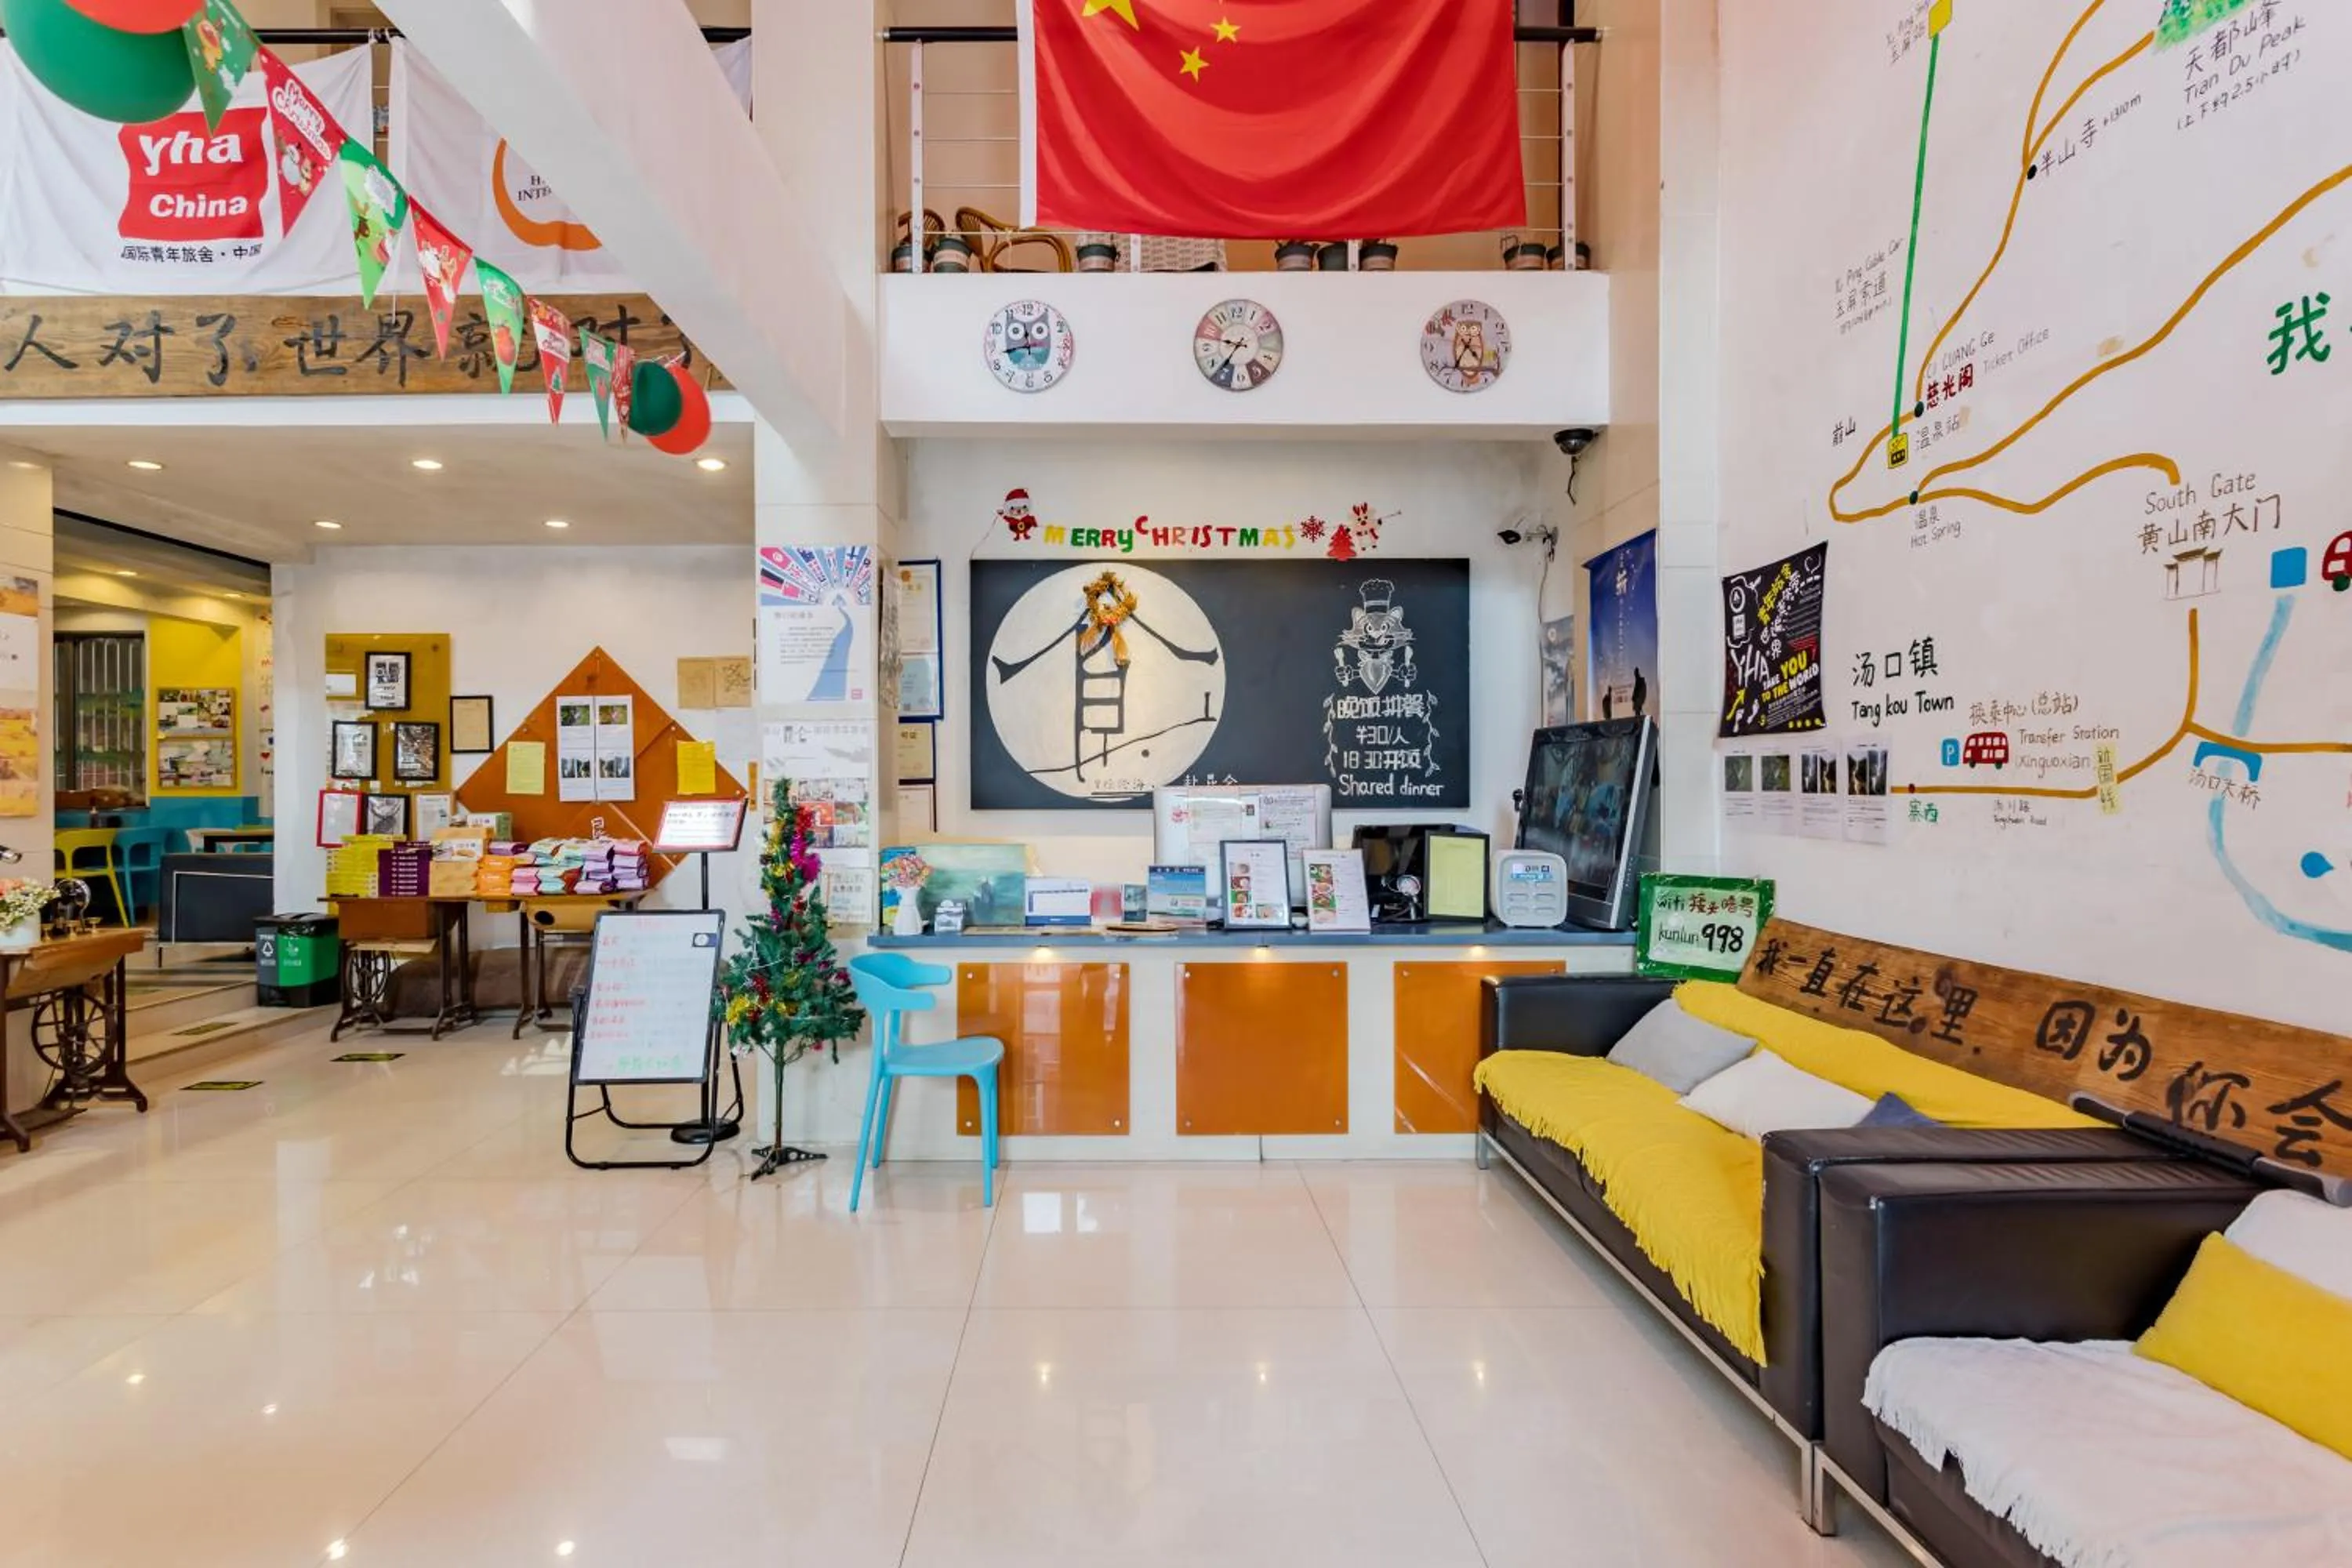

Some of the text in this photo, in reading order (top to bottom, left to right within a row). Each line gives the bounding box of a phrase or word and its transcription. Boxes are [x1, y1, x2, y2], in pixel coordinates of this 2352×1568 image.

[2184, 16, 2306, 104] Tian Du Peak
[139, 130, 243, 176] yha
[150, 194, 249, 218] China
[2266, 292, 2331, 375] 我
[2145, 473, 2256, 515] South Gate
[1134, 515, 1296, 547] CHRISTMAS
[1932, 521, 1961, 541] Spring
[2137, 493, 2281, 554] 黄山南大门
[1730, 644, 1770, 688] YHA
[1772, 681, 1789, 699] THE
[1788, 662, 1820, 691] WORLD
[1780, 650, 1807, 680] YOU
[1852, 636, 1939, 688] 汤口镇
[1915, 690, 1955, 713] Town
[2018, 725, 2120, 746] Transfer Station
[1338, 772, 1445, 797] Shared dinner
[2189, 769, 2262, 811] 汤口大桥
[1701, 923, 1744, 953] 998
